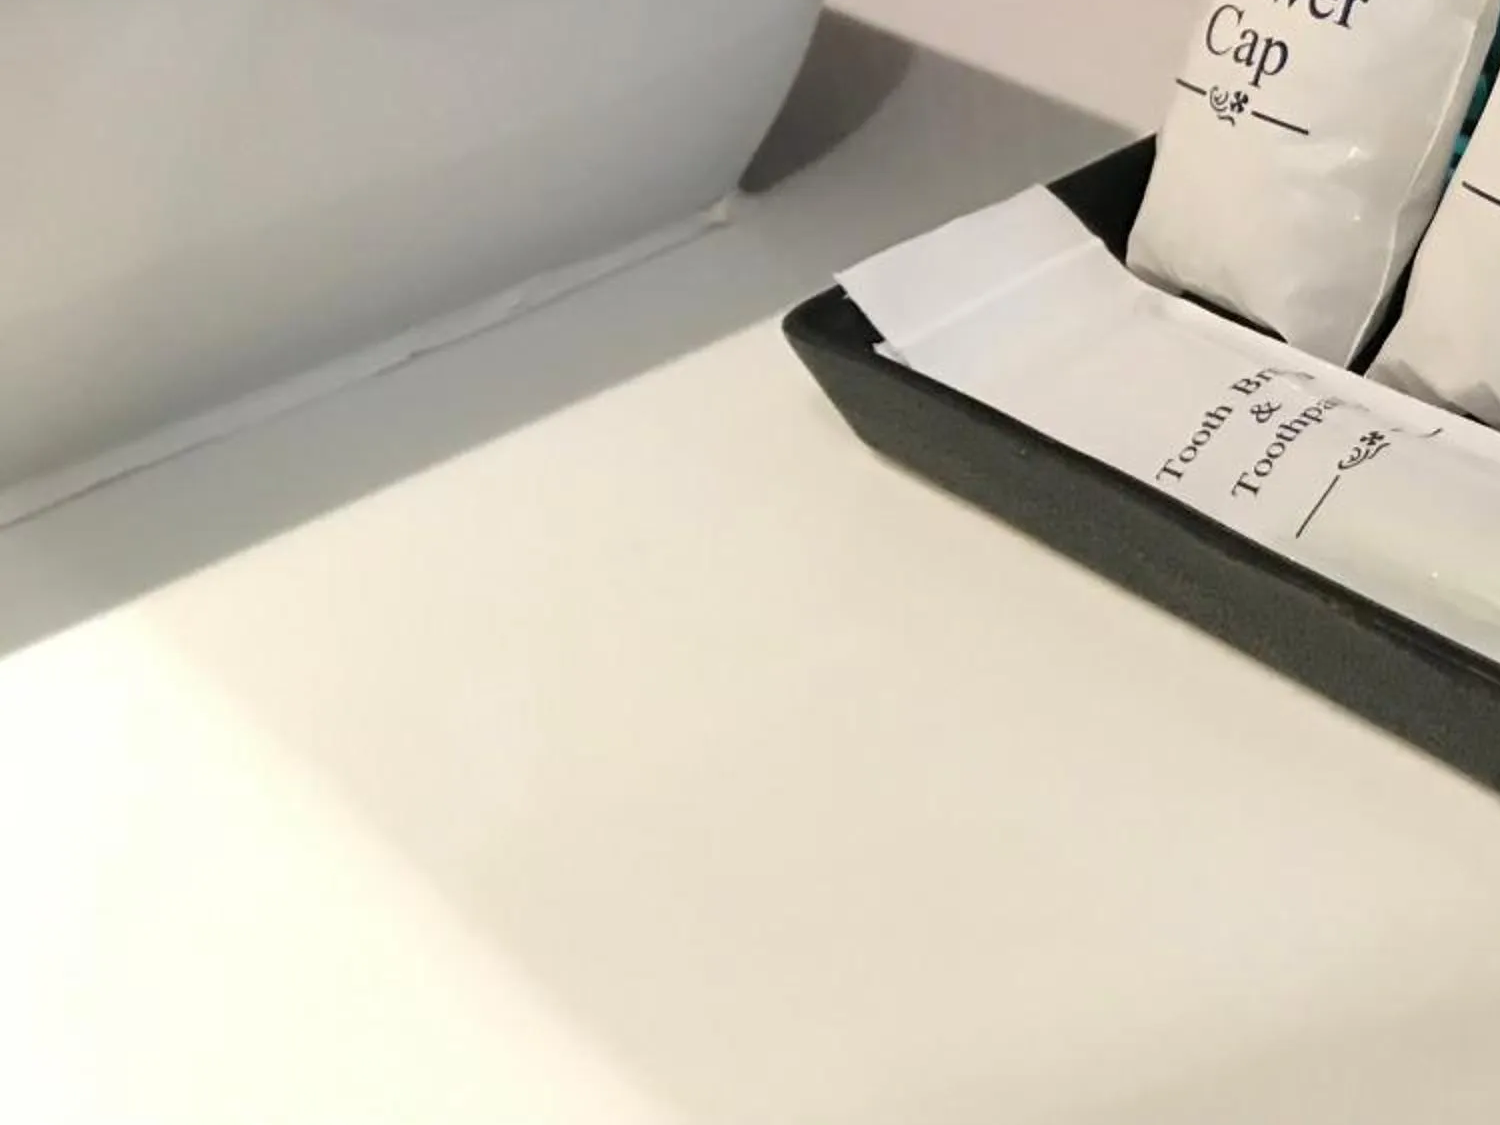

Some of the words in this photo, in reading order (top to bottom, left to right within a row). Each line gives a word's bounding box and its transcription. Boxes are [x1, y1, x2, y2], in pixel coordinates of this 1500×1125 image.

[1205, 4, 1289, 87] Cap
[1156, 403, 1233, 482] Tooth
[1249, 398, 1283, 424] &
